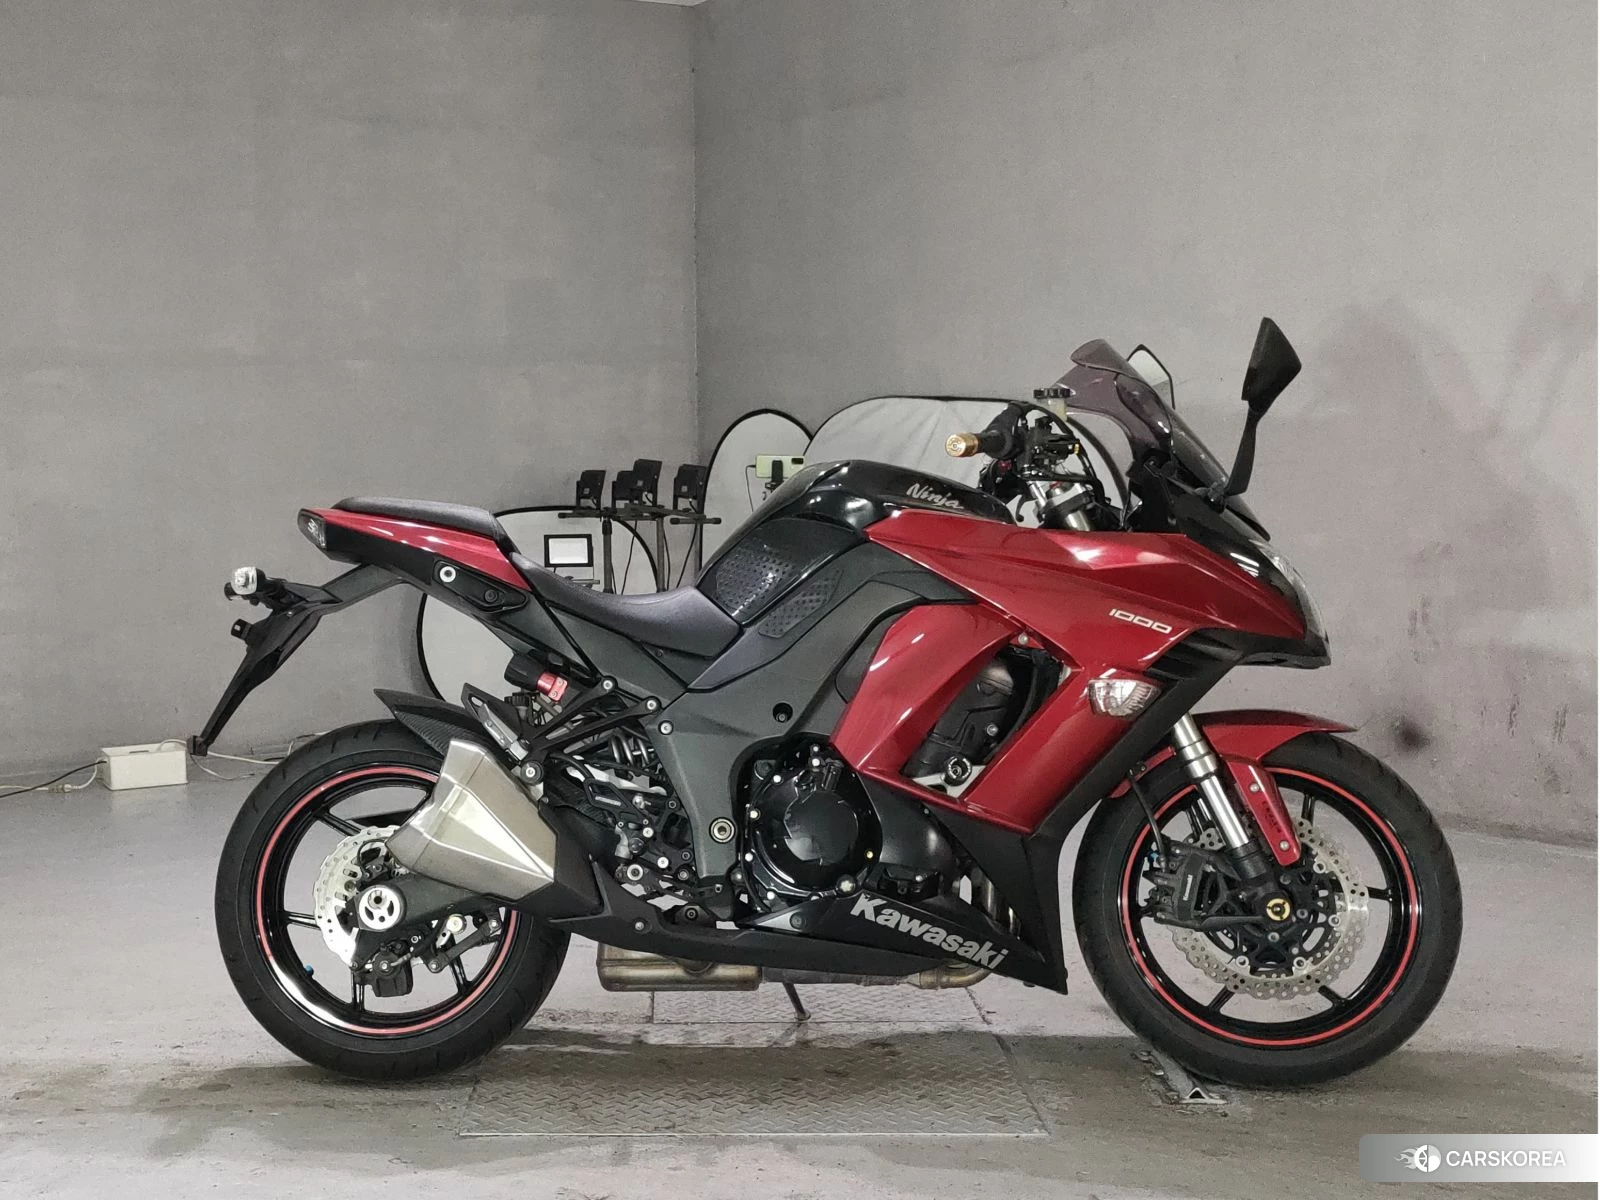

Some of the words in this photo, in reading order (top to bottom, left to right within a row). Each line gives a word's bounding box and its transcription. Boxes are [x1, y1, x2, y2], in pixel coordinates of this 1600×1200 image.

[906, 483, 964, 509] Ninja
[1109, 609, 1172, 634] 1000
[850, 893, 1009, 970] Kawasaki
